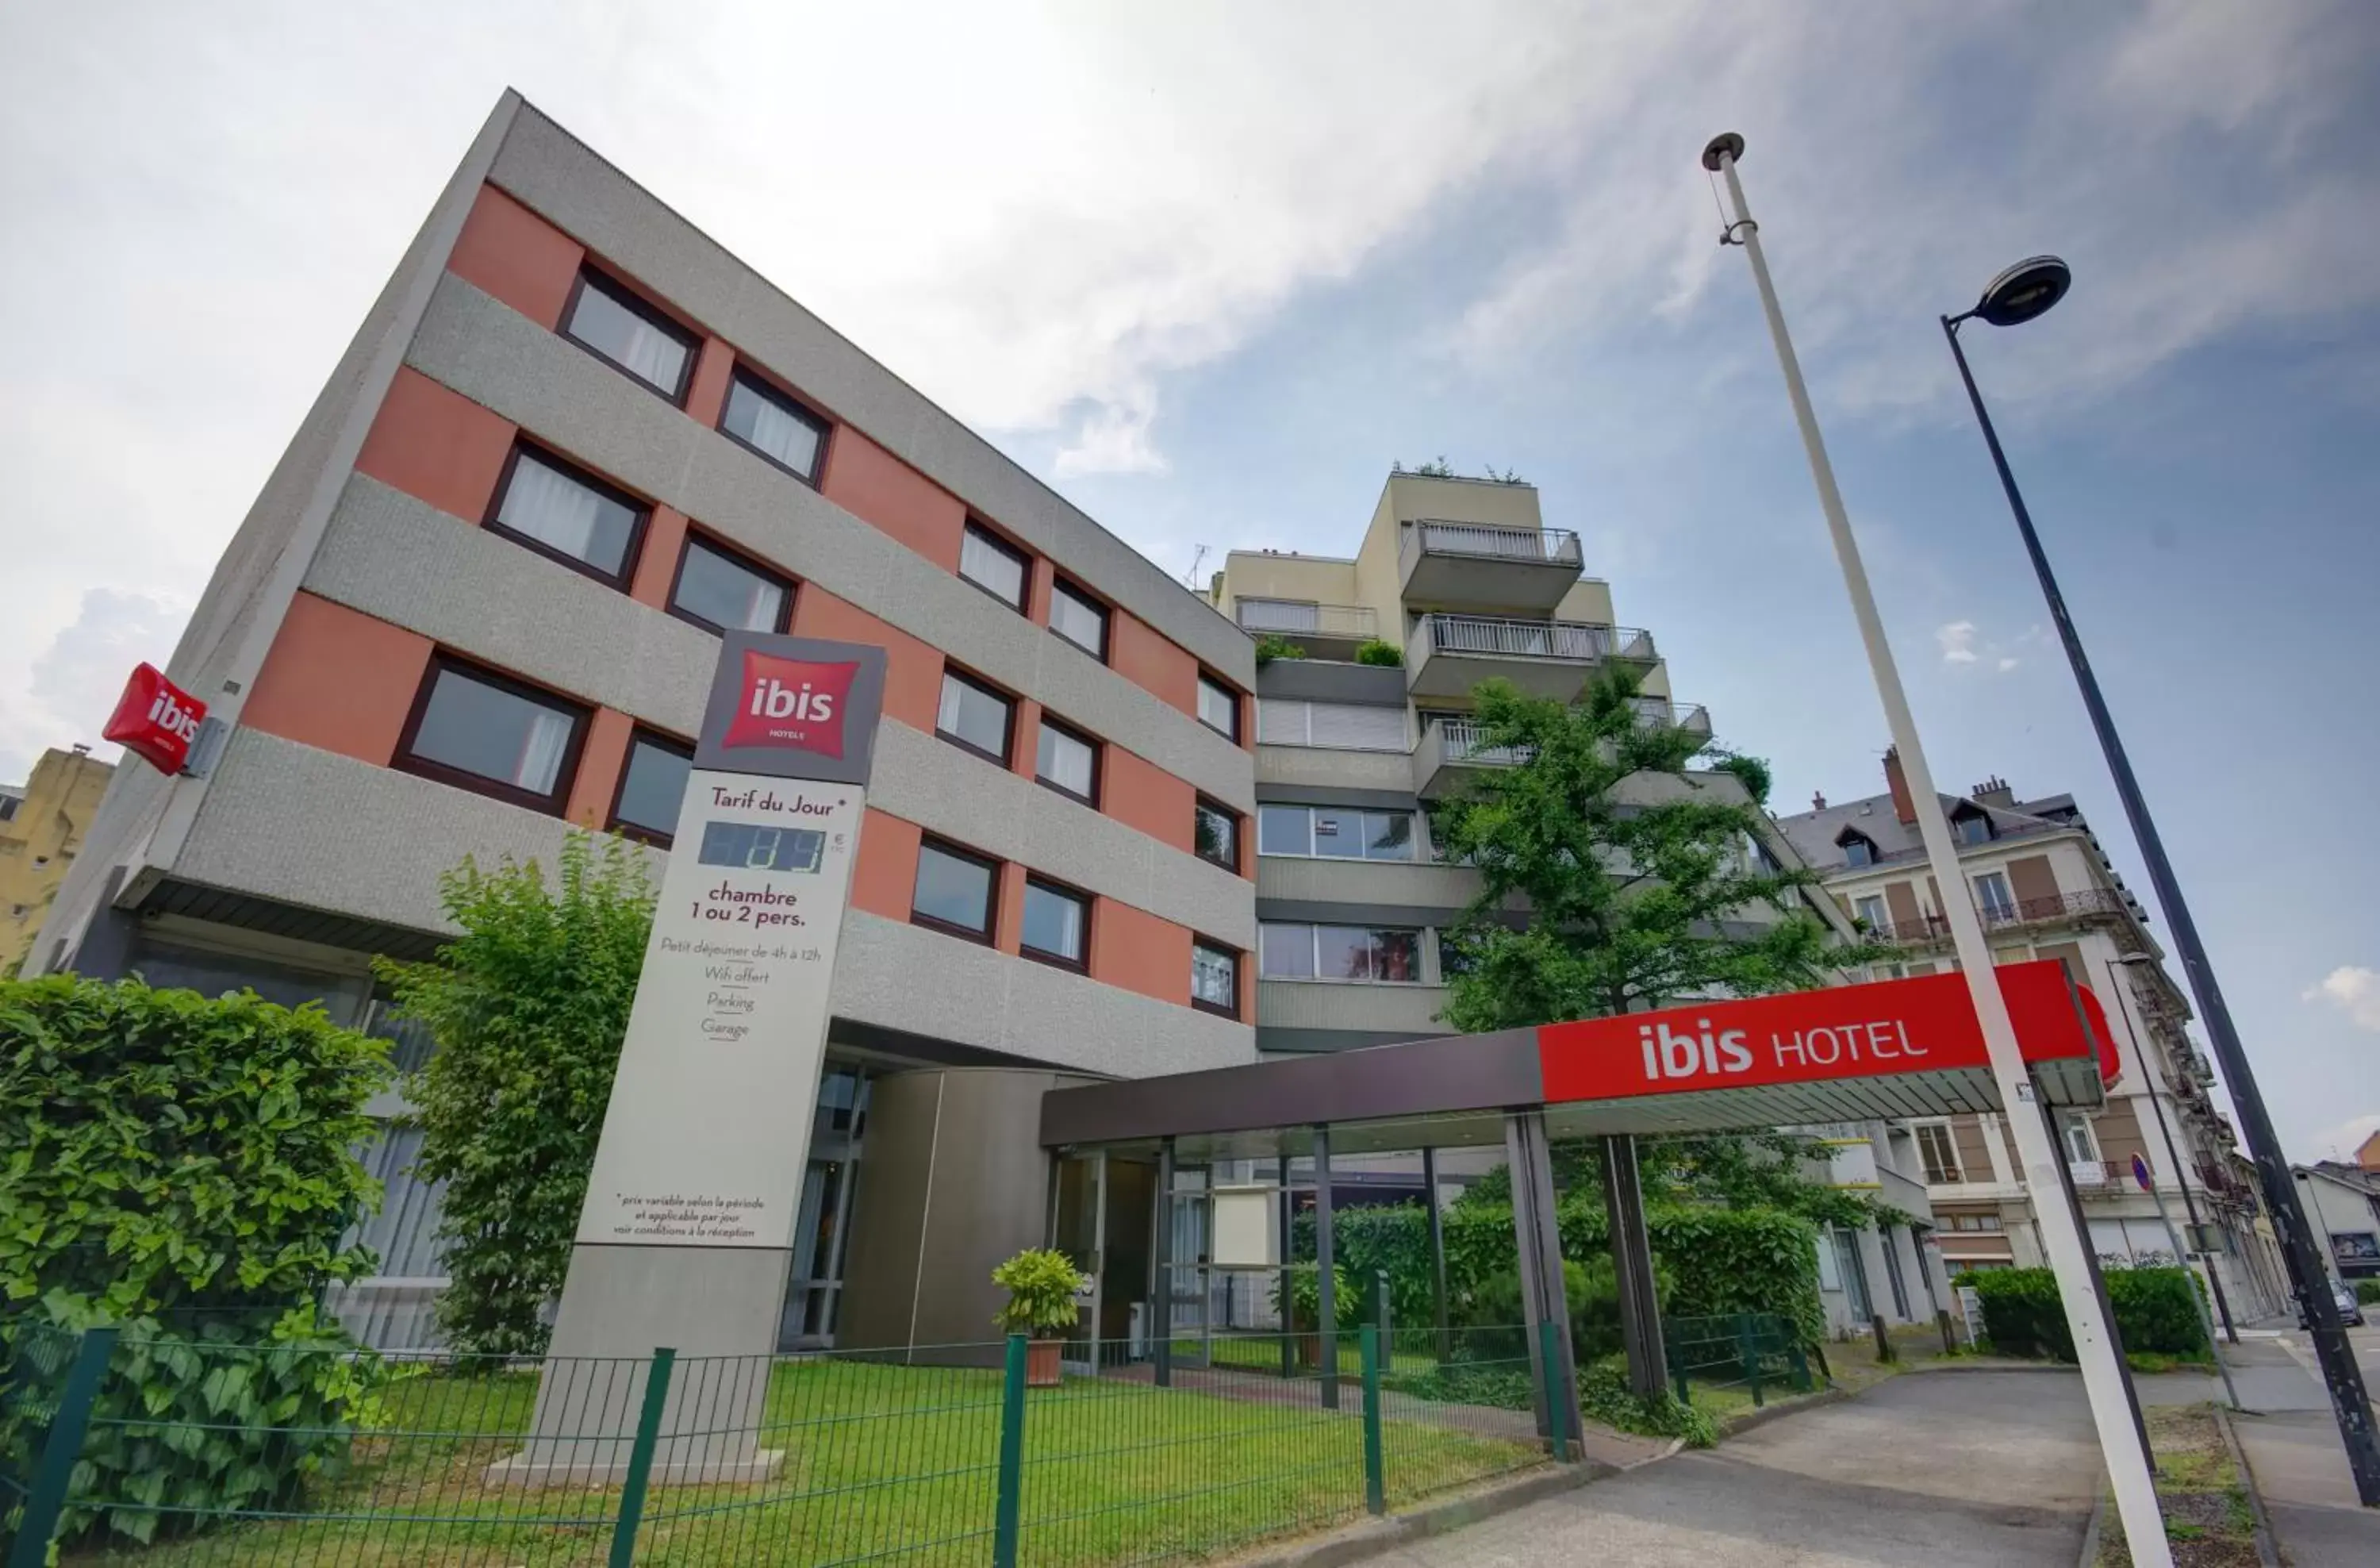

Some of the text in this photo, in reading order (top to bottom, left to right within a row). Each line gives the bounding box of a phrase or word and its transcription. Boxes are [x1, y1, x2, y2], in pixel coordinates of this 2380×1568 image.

[750, 678, 833, 722] ibis
[148, 690, 200, 744] ibis
[769, 728, 806, 741] HOTELS
[712, 786, 834, 817] Tarif du Jour
[708, 879, 797, 906] chambre
[691, 901, 806, 929] 1 ou 2 pers.
[660, 937, 691, 952] Petit
[751, 943, 767, 958] de
[704, 966, 770, 984] Wifi offert
[707, 992, 754, 1012] Parking
[701, 1018, 750, 1038] Garage
[1638, 1017, 1929, 1081] ibis HOTEL
